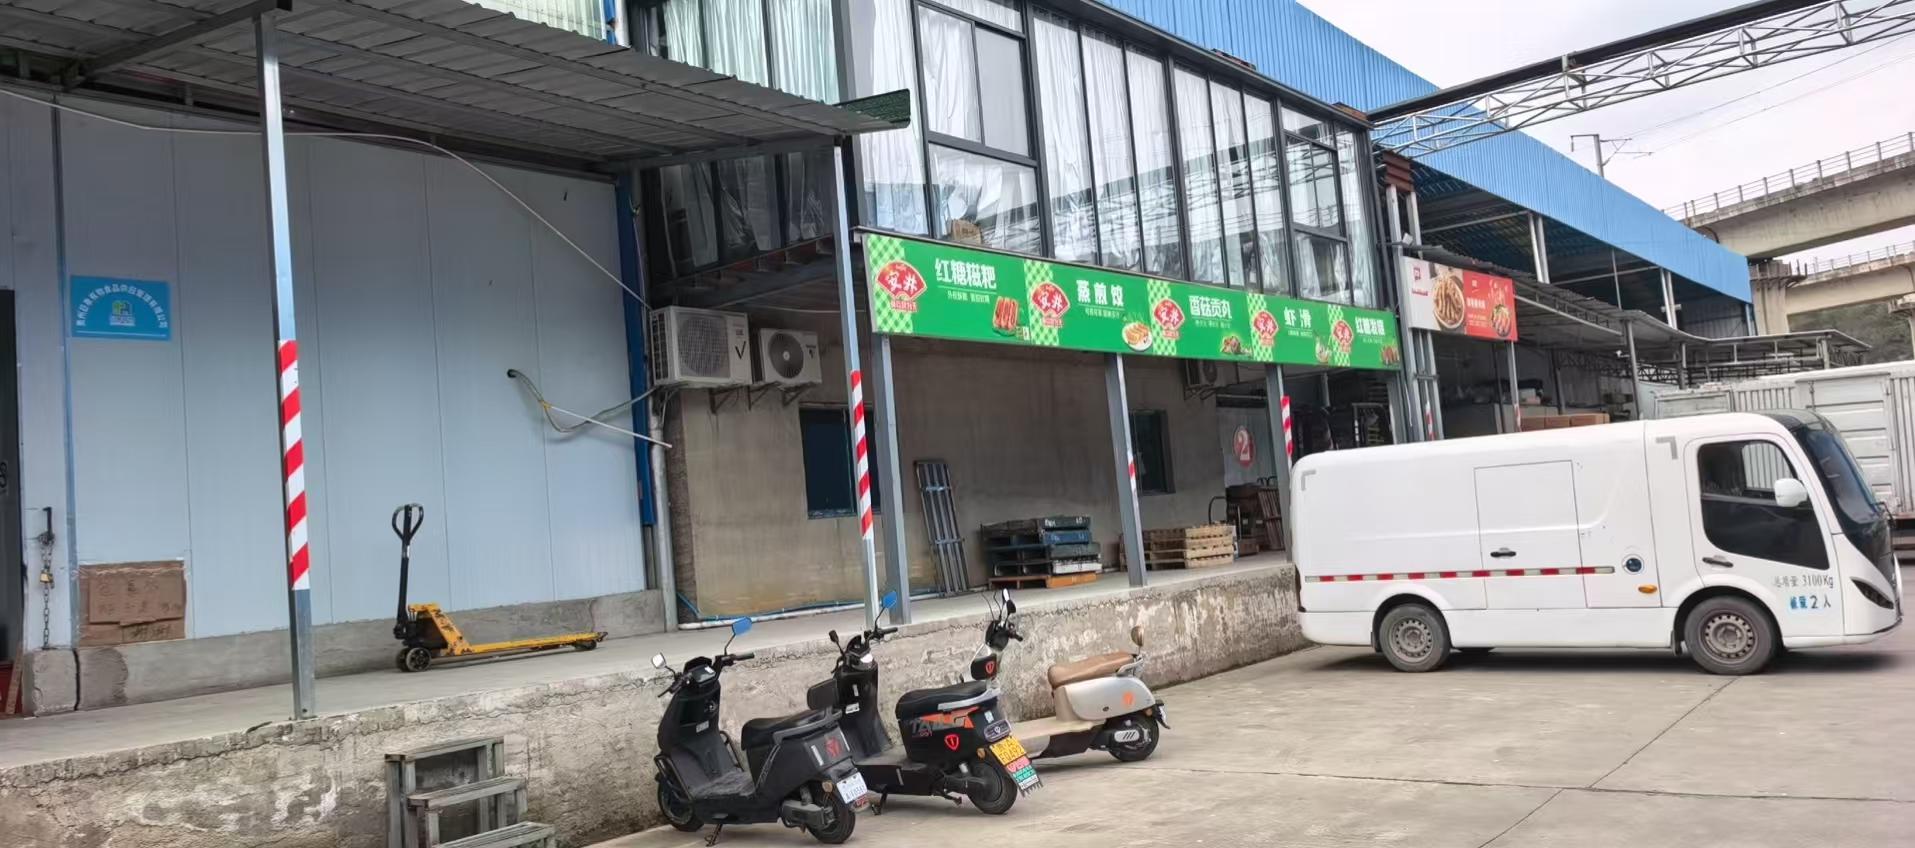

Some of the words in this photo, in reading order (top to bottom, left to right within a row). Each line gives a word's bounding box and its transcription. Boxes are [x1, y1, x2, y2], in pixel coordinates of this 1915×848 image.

[886, 271, 918, 294] 安井
[935, 258, 997, 289] 红糖糍粑
[1076, 280, 1124, 306] 蒸煎饺
[1189, 295, 1232, 318] 香菇贡丸
